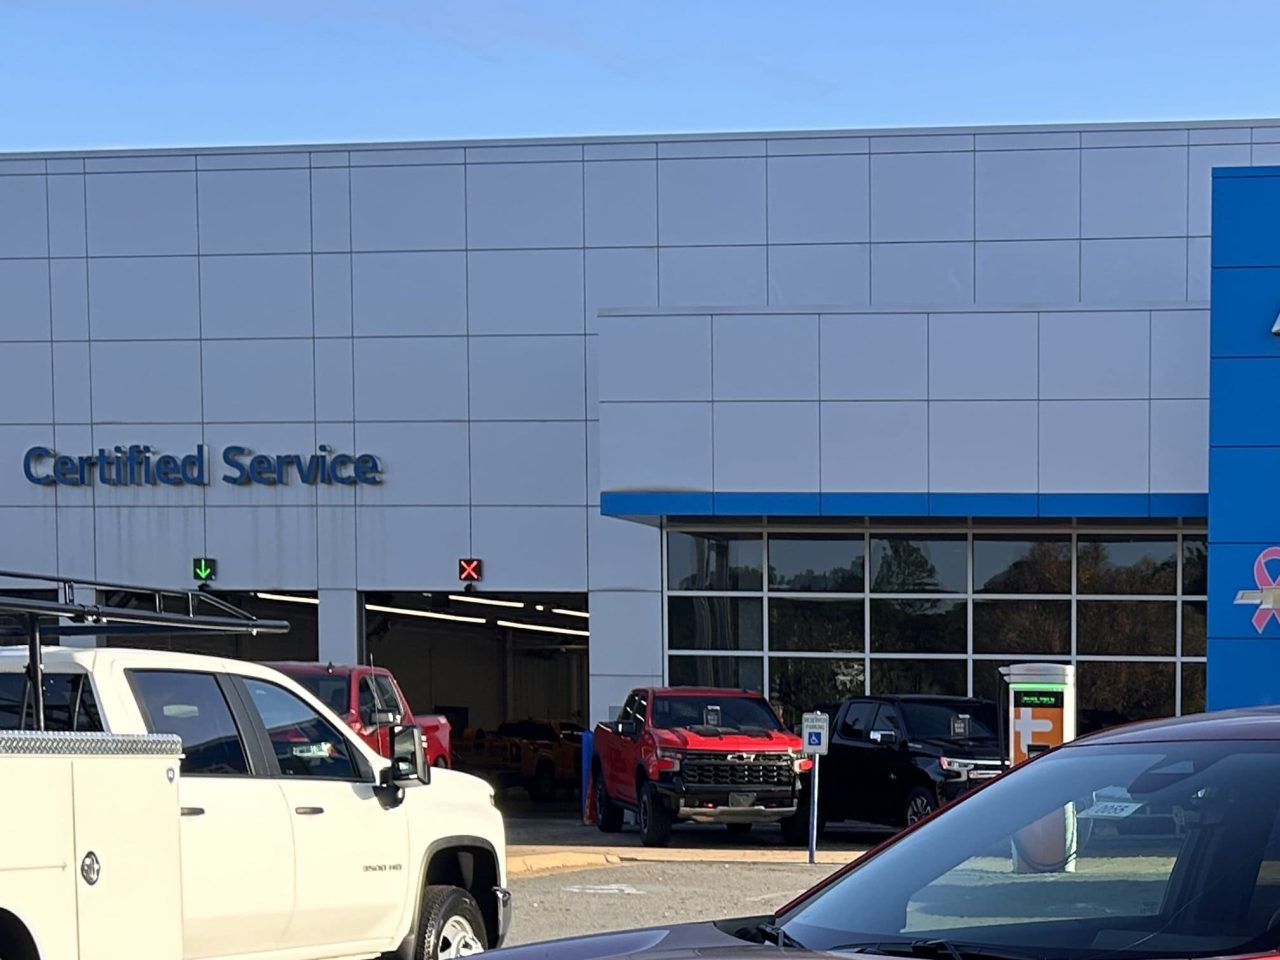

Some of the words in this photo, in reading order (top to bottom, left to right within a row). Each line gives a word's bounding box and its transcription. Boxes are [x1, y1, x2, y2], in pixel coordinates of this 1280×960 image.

[24, 444, 208, 486] Certified
[222, 444, 383, 486] Service
[389, 863, 402, 871] HD
